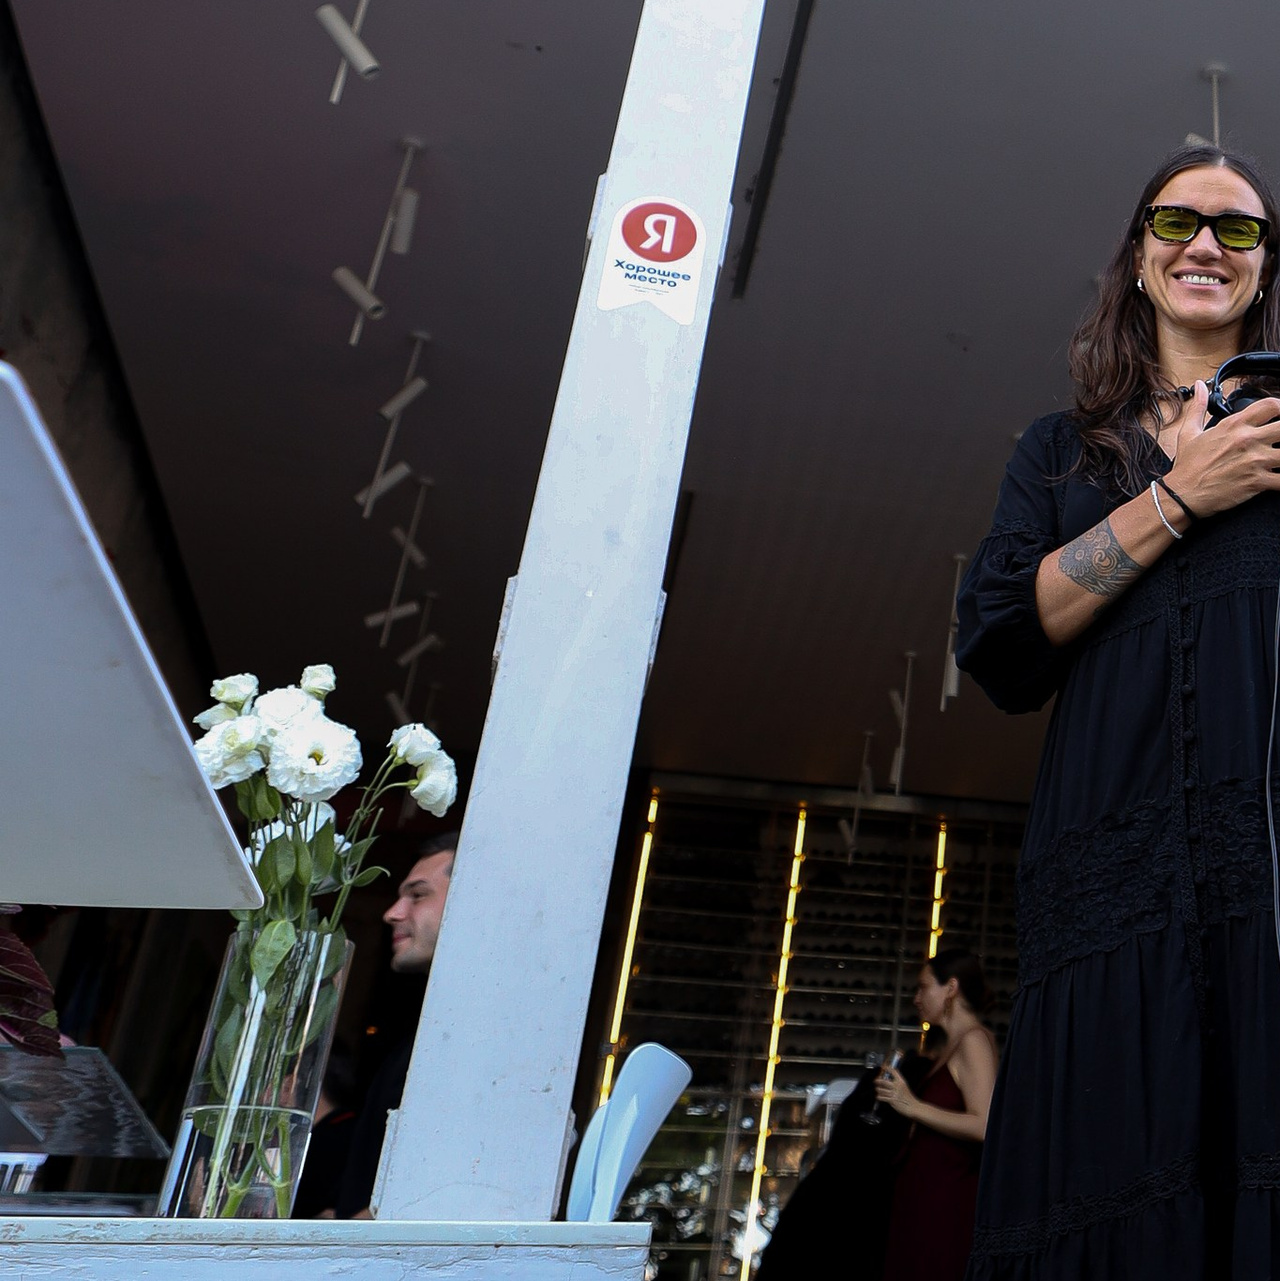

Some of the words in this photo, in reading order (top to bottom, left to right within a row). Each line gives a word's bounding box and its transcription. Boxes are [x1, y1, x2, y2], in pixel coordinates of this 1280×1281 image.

[639, 213, 676, 254] Я
[614, 259, 691, 281] Хорошее
[624, 272, 677, 287] место
